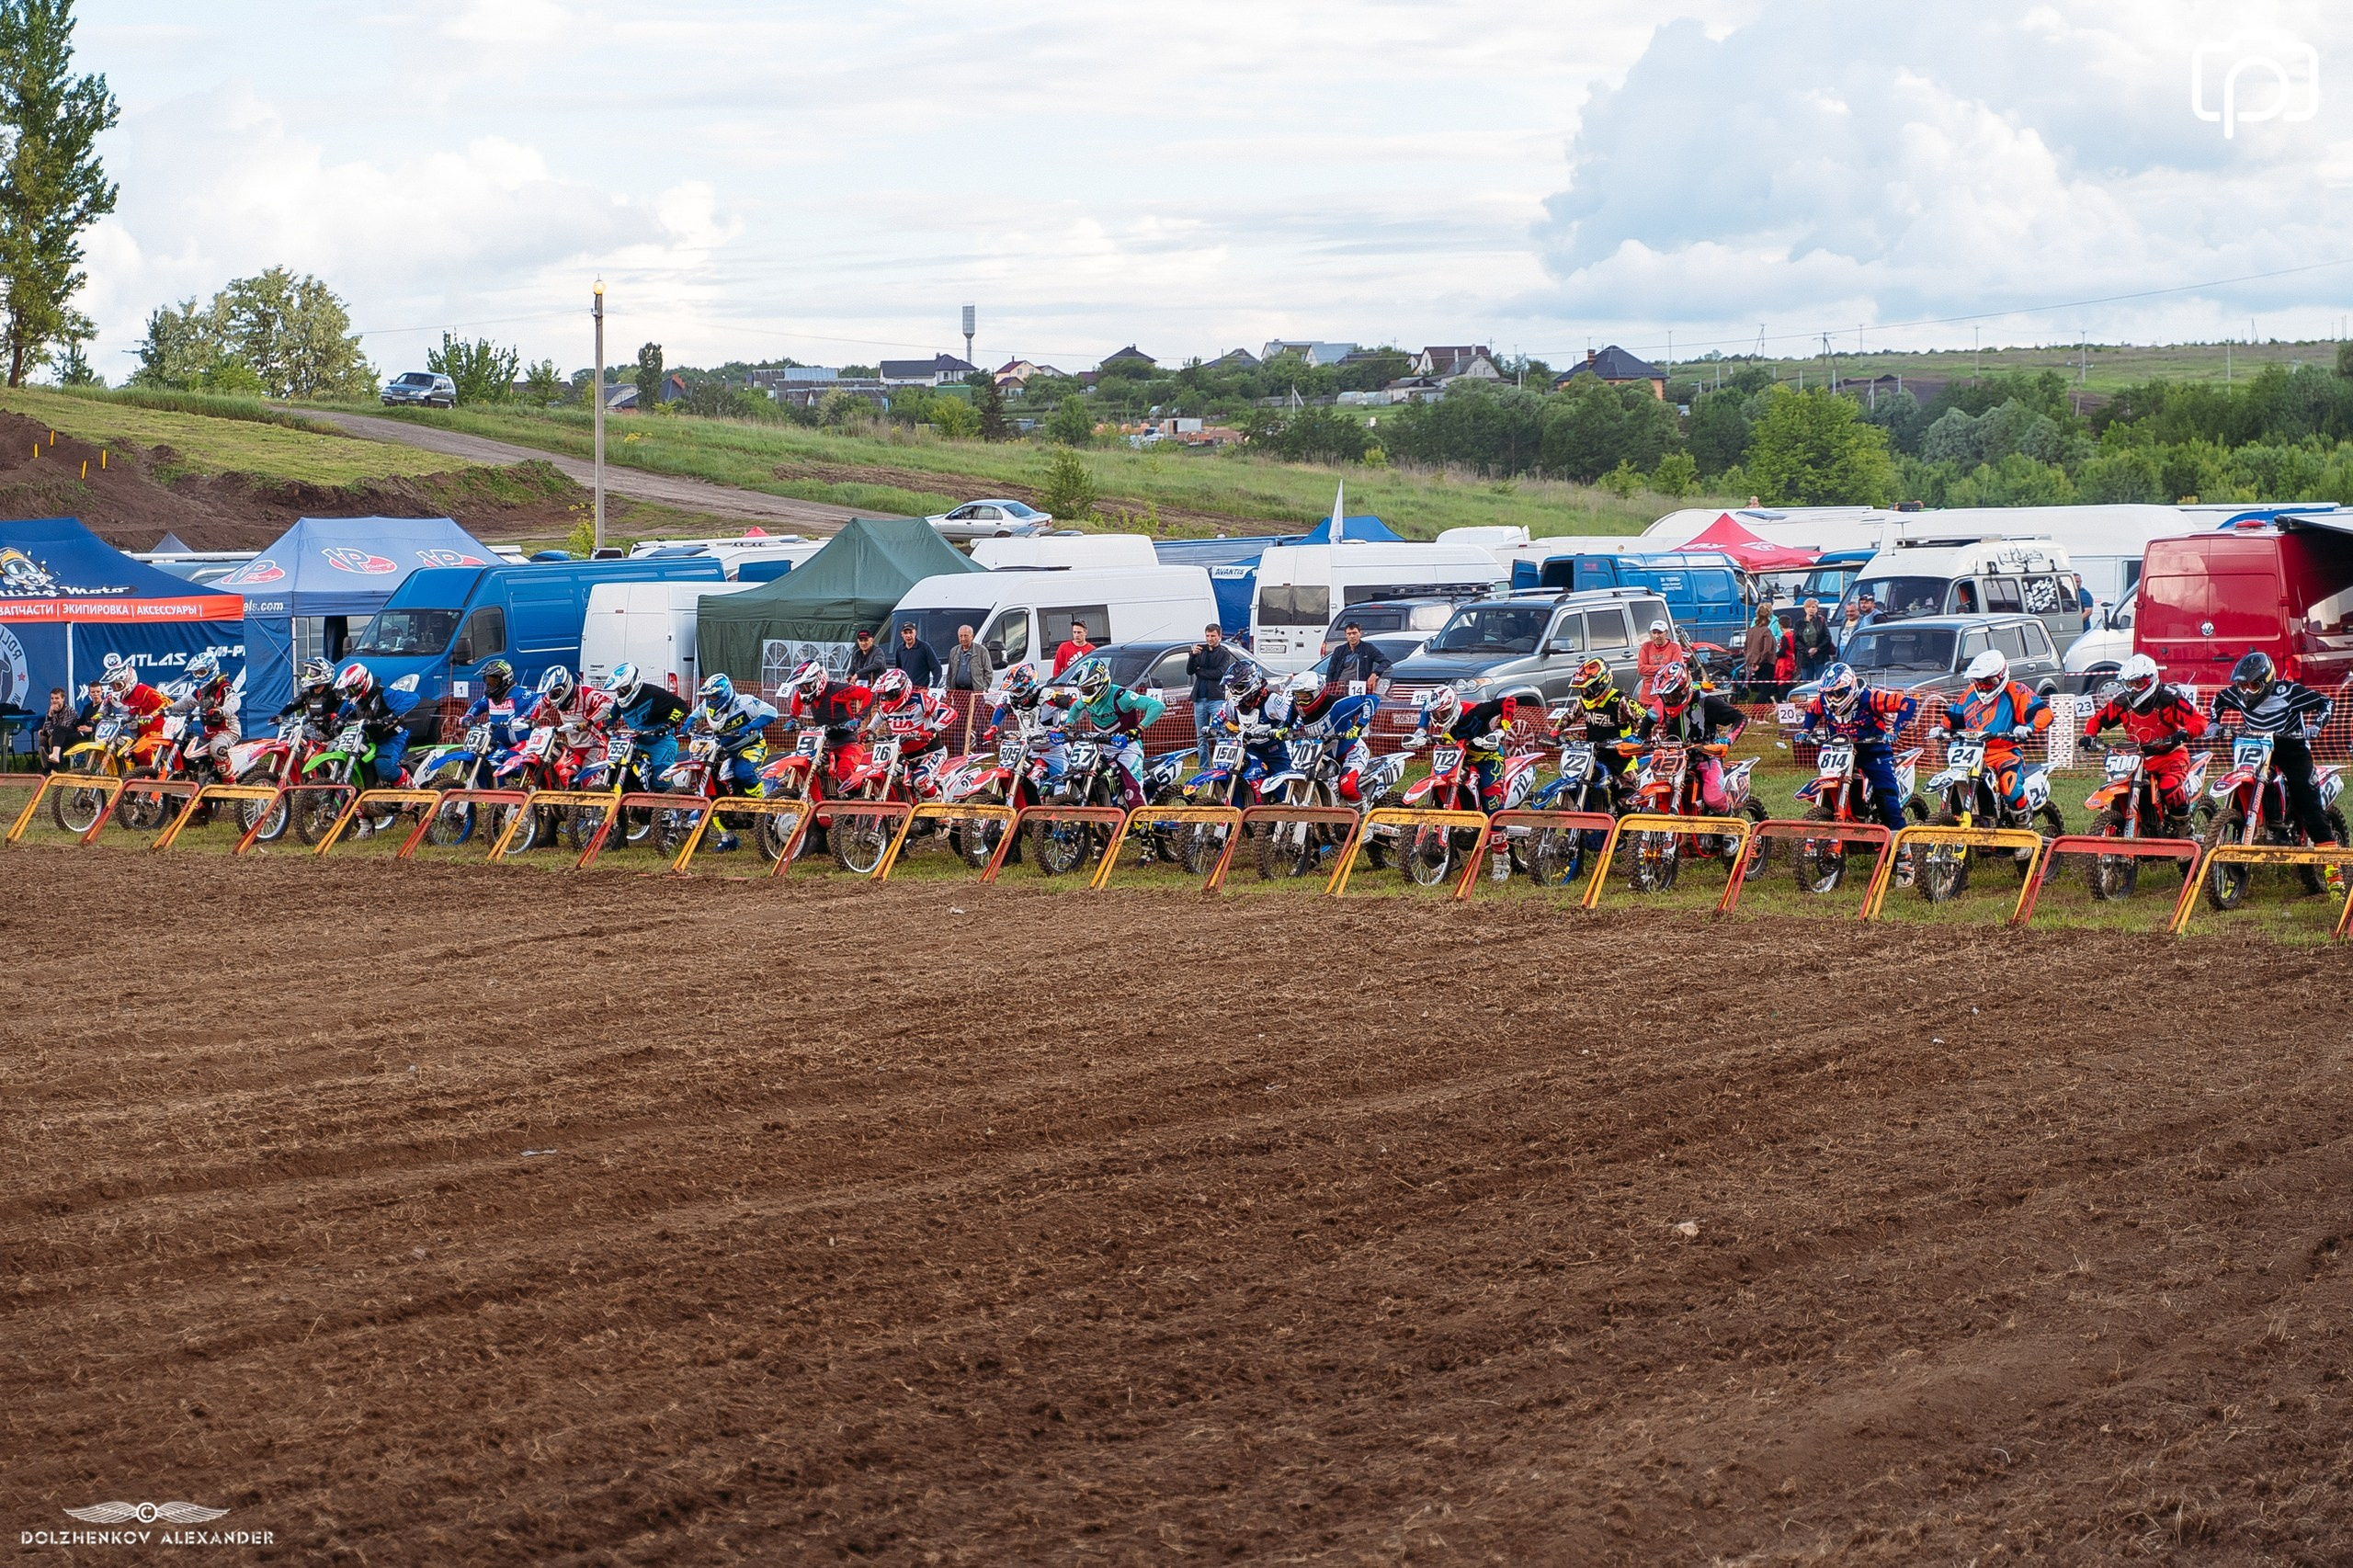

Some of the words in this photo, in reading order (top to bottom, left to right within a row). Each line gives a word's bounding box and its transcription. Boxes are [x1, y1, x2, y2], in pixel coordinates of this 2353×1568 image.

[62, 603, 130, 615] ЭКИПИРОВКА
[136, 604, 198, 616] АКСЕССУАРЫ
[120, 653, 188, 668] ATLAS
[1351, 686, 1363, 694] 14
[1779, 709, 1795, 720] 20
[2076, 701, 2093, 713] 23
[608, 742, 629, 755] 755
[873, 745, 892, 762] 26
[999, 746, 1021, 762] 505
[1070, 748, 1097, 764] 57
[1216, 746, 1237, 760] 150
[1293, 744, 1320, 763] 701
[1950, 748, 1976, 764] 24
[2237, 747, 2263, 764] 12
[1435, 752, 1458, 767] 712
[1563, 754, 1588, 771] 22
[1820, 753, 1848, 768] 814
[2104, 755, 2141, 772] 500
[1156, 763, 1177, 786] 57
